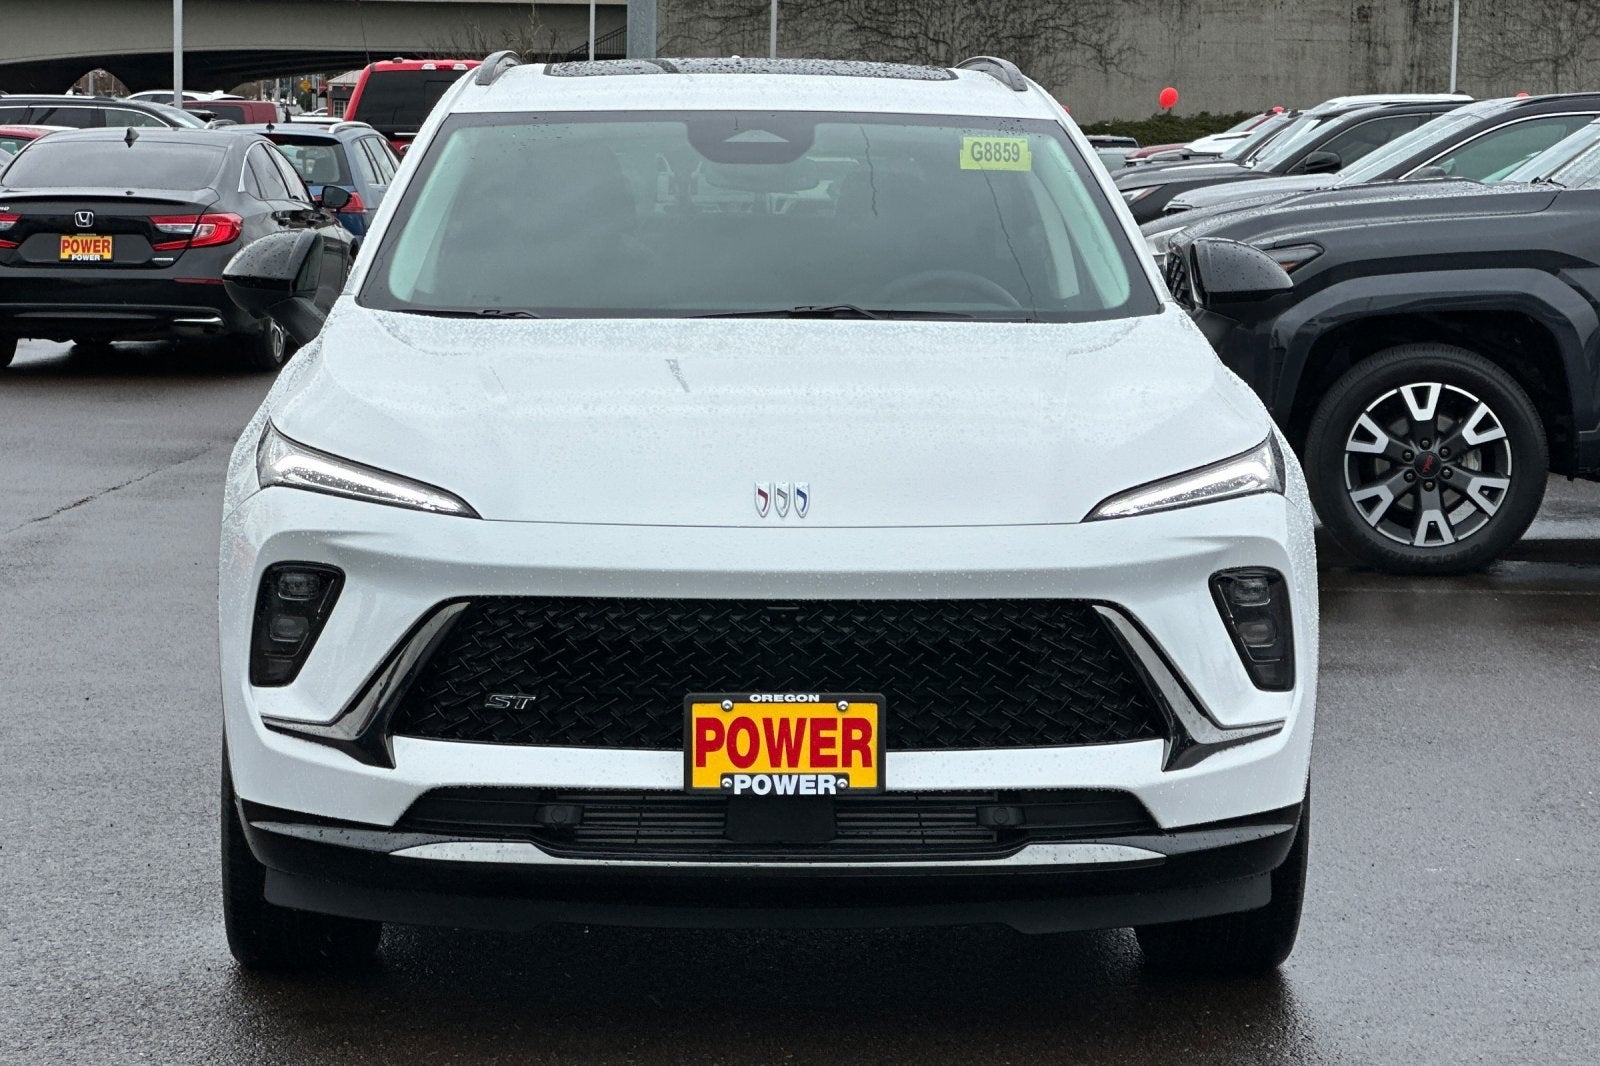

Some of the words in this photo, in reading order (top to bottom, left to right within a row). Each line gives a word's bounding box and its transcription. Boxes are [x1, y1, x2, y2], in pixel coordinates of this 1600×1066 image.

[971, 141, 1020, 162] G8859
[62, 239, 111, 253] POWER
[484, 693, 536, 709] ST
[749, 694, 820, 703] OREGON
[695, 716, 873, 769] POWER
[733, 774, 837, 795] POWER
